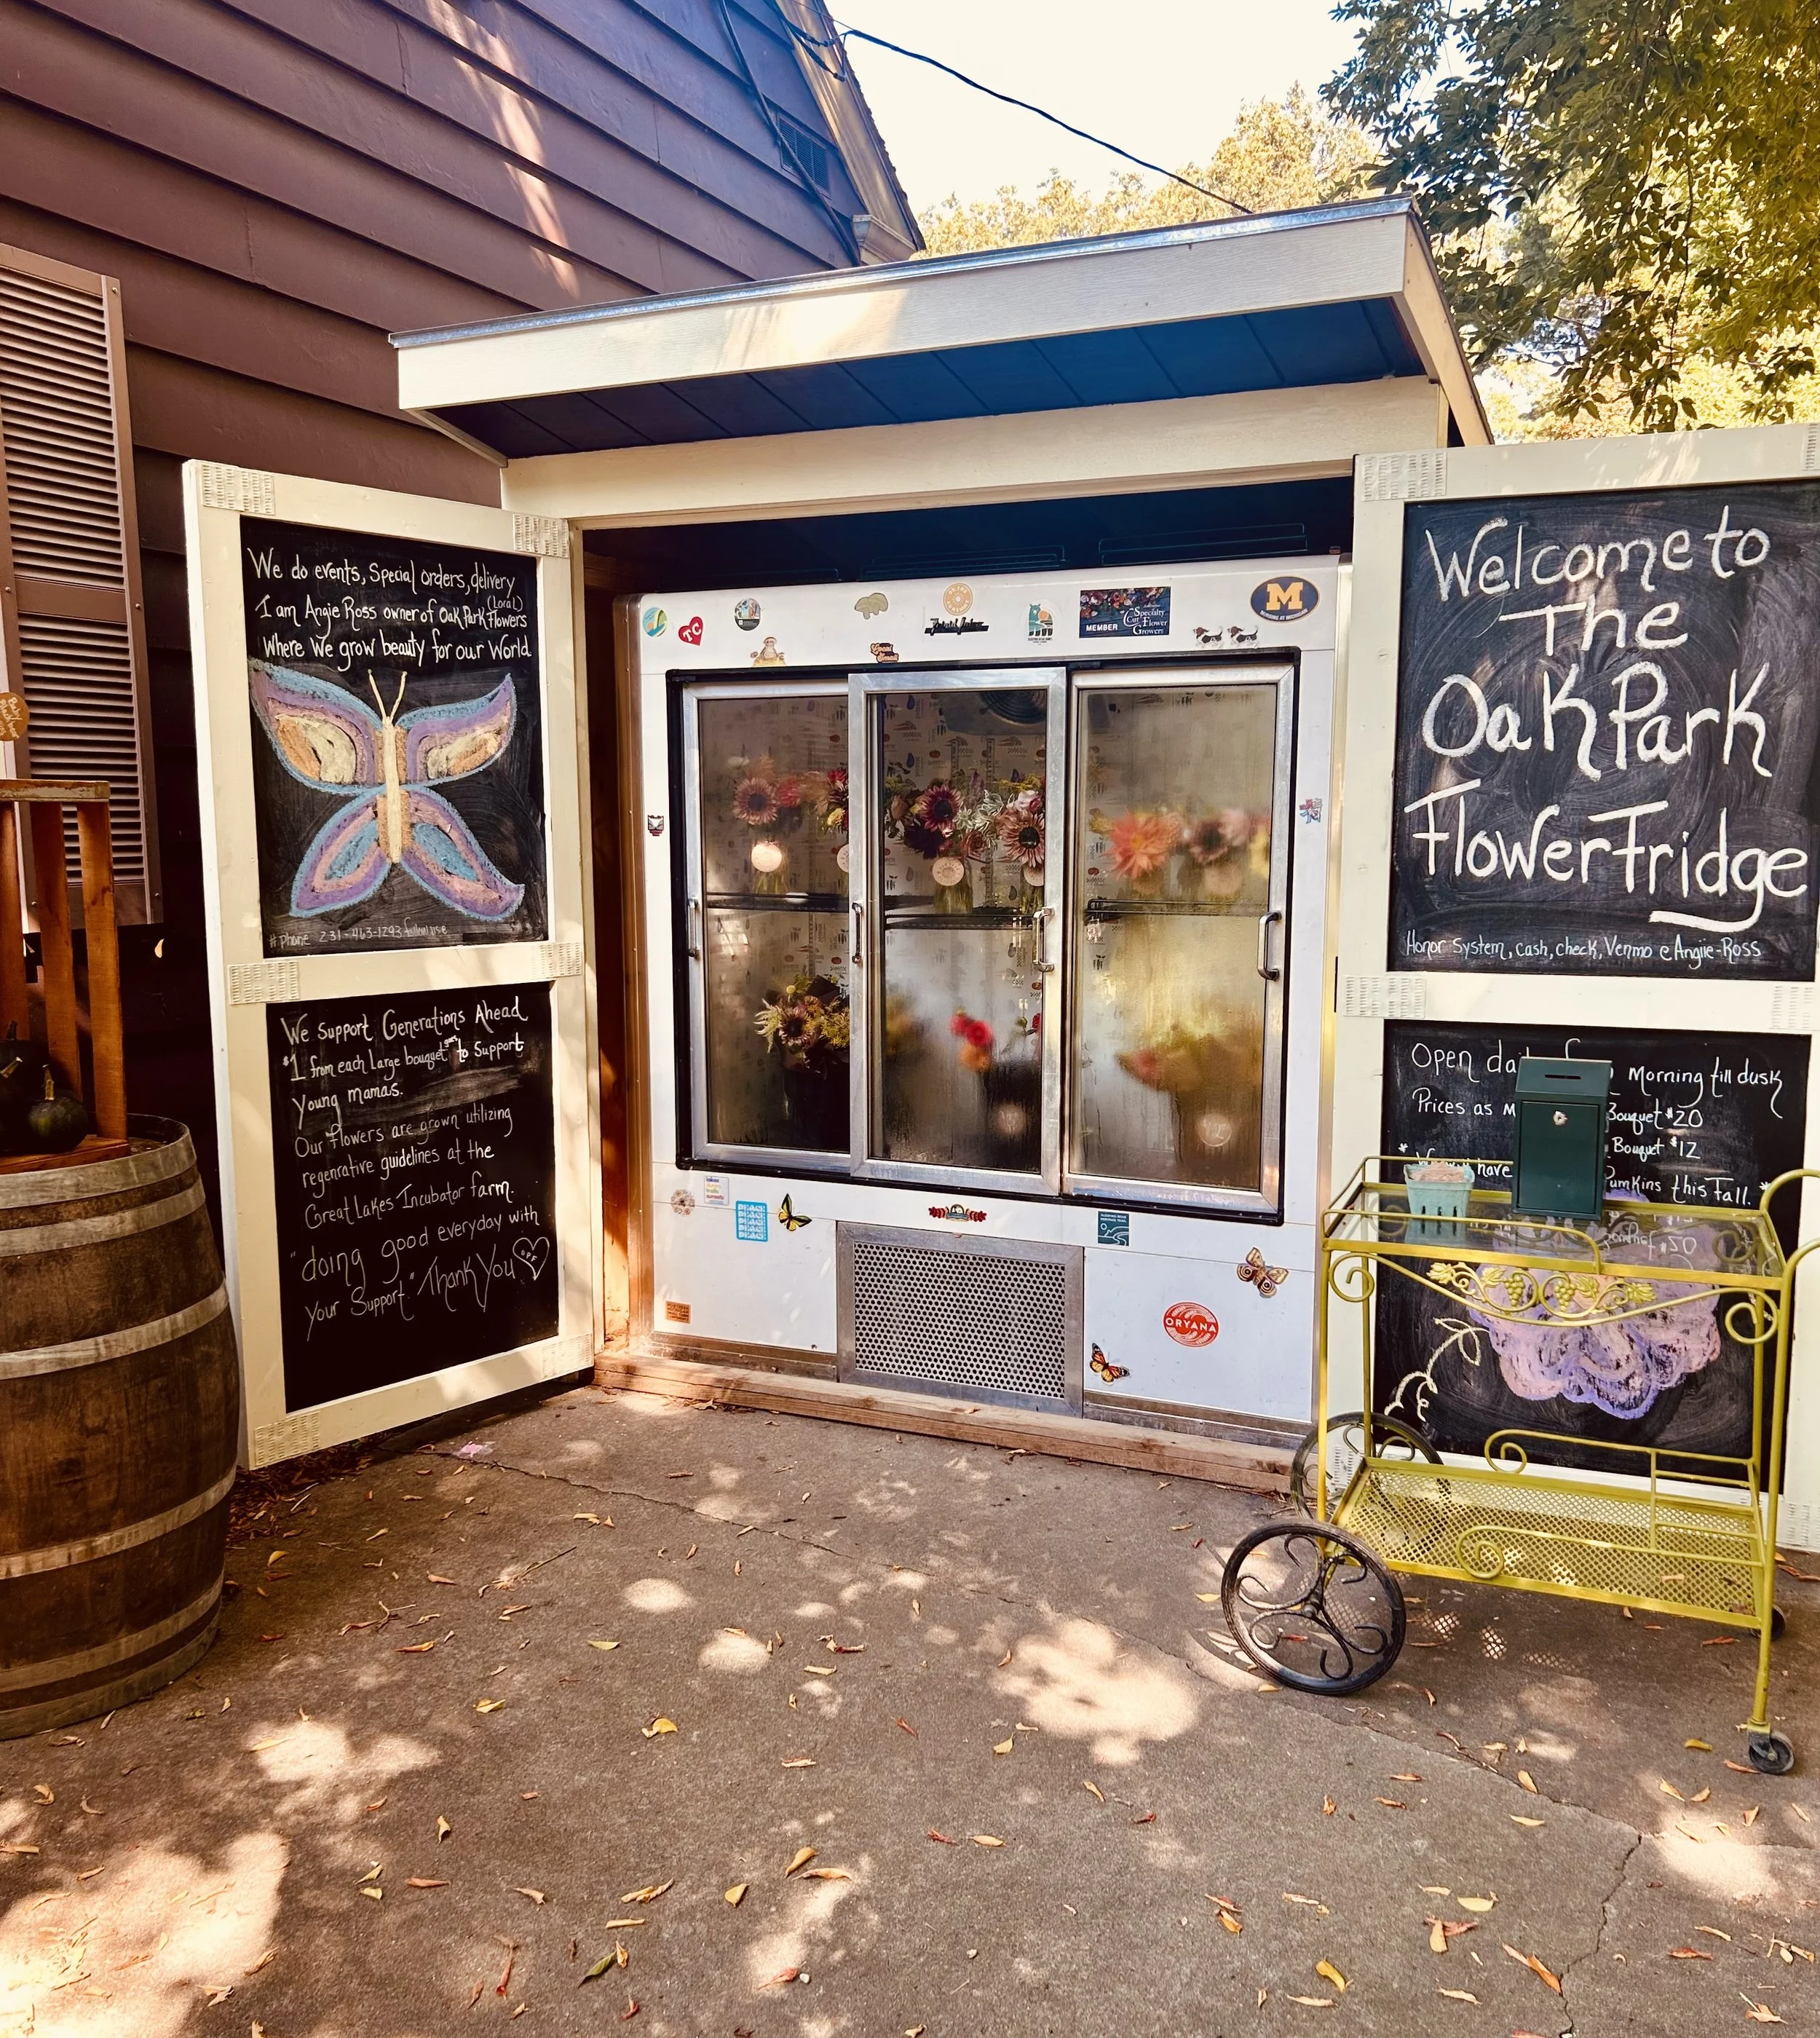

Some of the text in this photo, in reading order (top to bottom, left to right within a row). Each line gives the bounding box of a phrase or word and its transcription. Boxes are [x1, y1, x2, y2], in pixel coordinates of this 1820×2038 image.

[248, 548, 282, 580] We
[291, 554, 308, 580] do
[315, 558, 365, 585] events,
[421, 563, 470, 595] orders,
[471, 562, 515, 598] delivery
[1425, 505, 1771, 604] Welcome to
[255, 594, 527, 639] I am Angie Ross owner of Oak Park Flowers
[1133, 606, 1165, 618] Specialty
[1266, 582, 1303, 611] M
[682, 623, 702, 641] TC
[1085, 623, 1118, 632] MEMBER
[1133, 625, 1165, 635] Growers
[1142, 616, 1168, 627] Flower
[1499, 593, 1689, 657] The
[338, 638, 376, 671] grow
[380, 629, 425, 667] beauty
[432, 628, 452, 663] for
[456, 644, 483, 660] our
[1421, 660, 1772, 783] Oak Park
[1404, 778, 1809, 933] Flower Fridge
[1406, 930, 1446, 956] Honor
[1452, 931, 1513, 961] System,
[1603, 936, 1652, 960] Venmo
[281, 995, 528, 1045] We Support Generations Ahead
[310, 1054, 336, 1081] from
[338, 1054, 367, 1075] each
[405, 1042, 448, 1070] bouquet
[456, 1038, 469, 1062] to
[474, 1032, 524, 1061] Support
[1411, 1043, 1480, 1083] Open
[1629, 1065, 1704, 1107] Morning
[1710, 1056, 1731, 1097] till
[1738, 1058, 1783, 1119] dusk
[292, 1094, 344, 1130] Young
[295, 1102, 513, 1158] Our Flowers are grown utilizing
[1412, 1087, 1465, 1115] Prices
[1473, 1102, 1493, 1115] as
[1666, 1105, 1704, 1128] $20
[381, 1142, 440, 1180] guidelines
[448, 1138, 462, 1164] at
[467, 1140, 494, 1161] the
[1612, 1136, 1701, 1162] Bouquet $12
[1477, 1157, 1514, 1177] have
[1672, 1174, 1707, 1203] this
[305, 1196, 355, 1229] Great
[357, 1196, 394, 1220] Lakes
[396, 1183, 464, 1209] Incubator
[381, 1226, 429, 1284] good
[438, 1214, 502, 1241] everyday
[509, 1205, 540, 1226] with
[305, 1300, 339, 1341] Your
[417, 1256, 478, 1312] Thank
[476, 1244, 515, 1312] You
[1166, 1317, 1217, 1332] ORYANA
